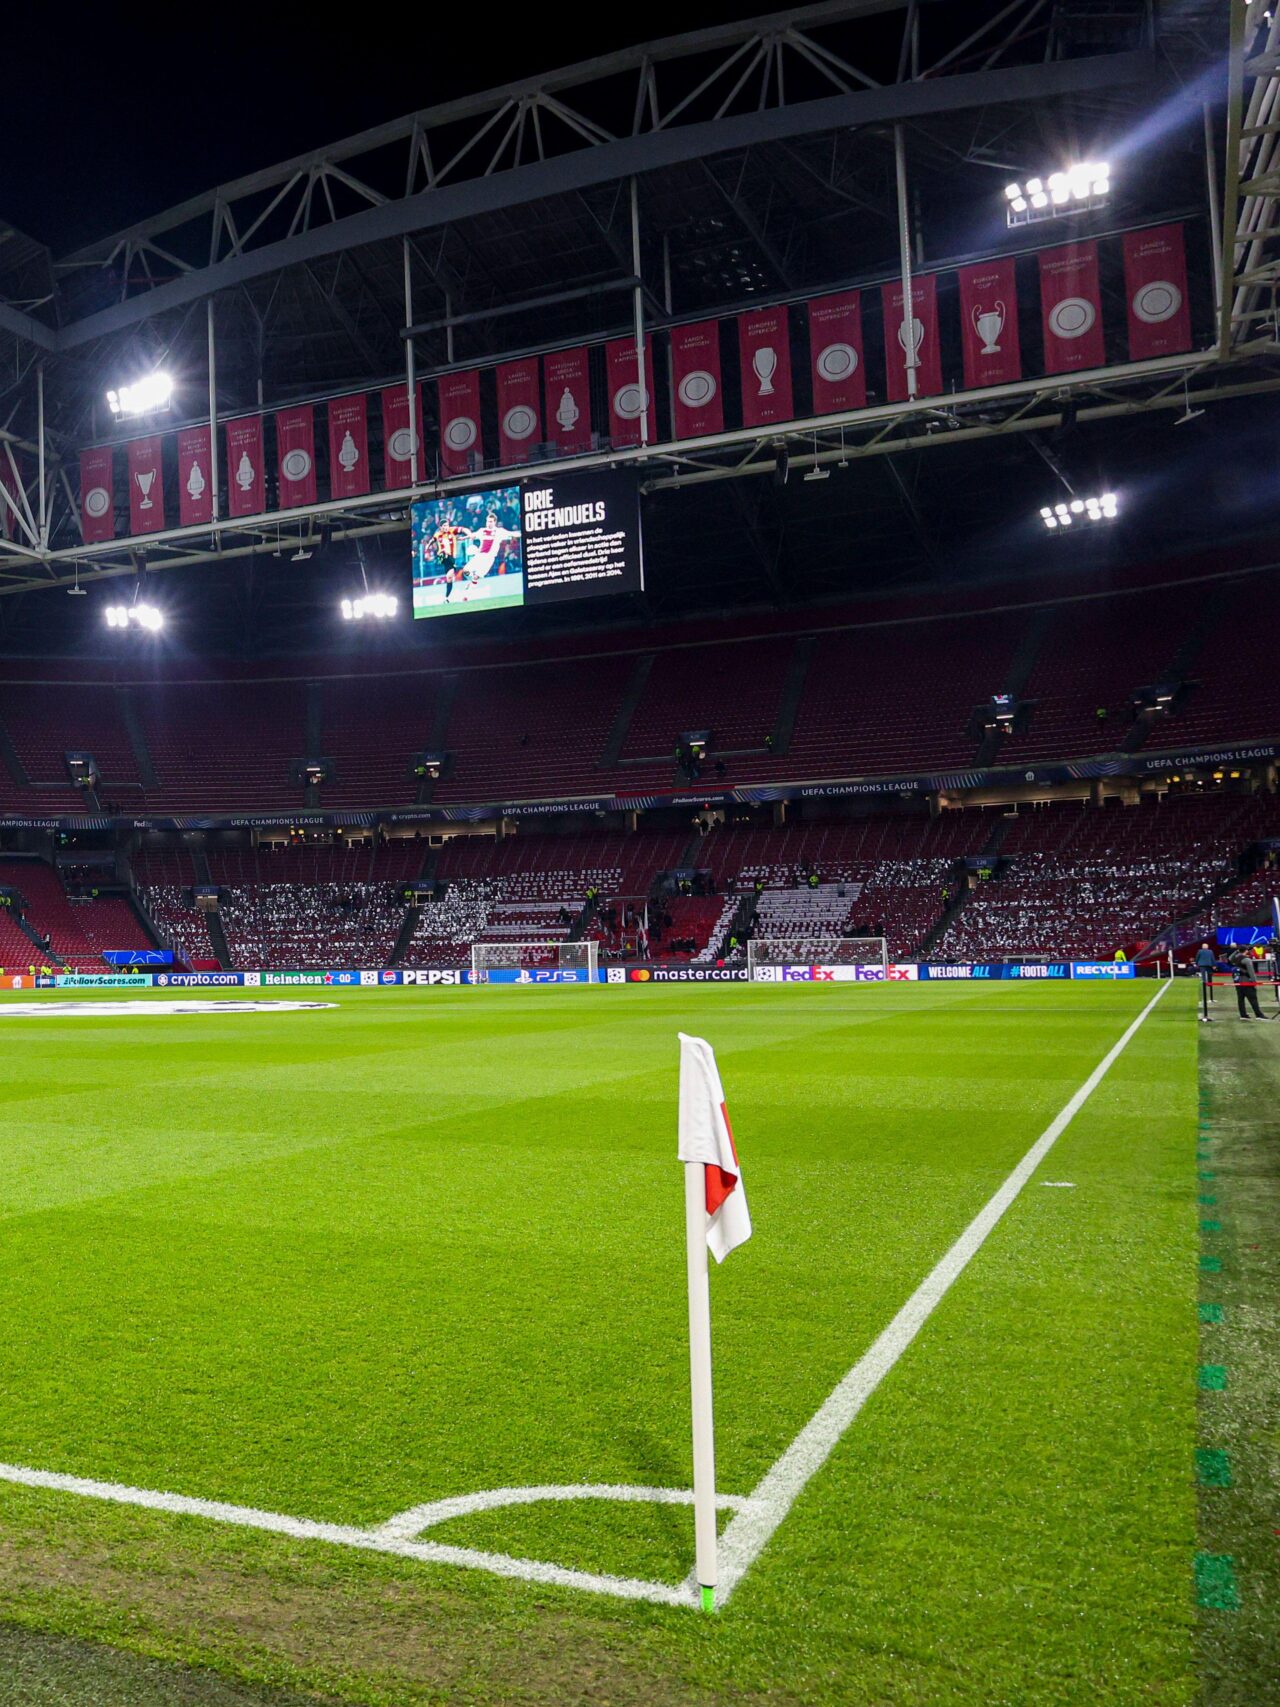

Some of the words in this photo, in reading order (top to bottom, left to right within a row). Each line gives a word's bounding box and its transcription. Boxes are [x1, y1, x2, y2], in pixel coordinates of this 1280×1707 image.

[524, 488, 554, 512] DRIE
[525, 501, 606, 532] OEFENDUELS
[1146, 759, 1174, 770] UEFA
[1175, 752, 1234, 767] CHAMPIONS
[1235, 747, 1275, 760] LEAGUE
[802, 787, 824, 796] UEFA
[826, 784, 882, 795] CHAMPIONS
[883, 781, 919, 791] LEAGUE
[502, 807, 521, 815] UEFA
[522, 804, 568, 814] CHAMPIONS
[570, 802, 600, 811] LEAGUE
[33, 820, 60, 828] LEAGUE
[250, 818, 294, 826] CHAMPIONS
[295, 817, 324, 825] LEAGUE
[536, 971, 577, 982] PS5
[653, 968, 748, 981] mastercard
[782, 965, 835, 981] FedEx
[855, 964, 910, 981] FedEx
[927, 965, 971, 978] WELCOME
[971, 966, 990, 977] ALL
[1009, 964, 1065, 977] #FOOTBALL
[1076, 965, 1130, 975] RECYCLE
[170, 975, 238, 987] crypto.com
[265, 973, 322, 985] Heineken
[402, 970, 461, 984] PEPSI
